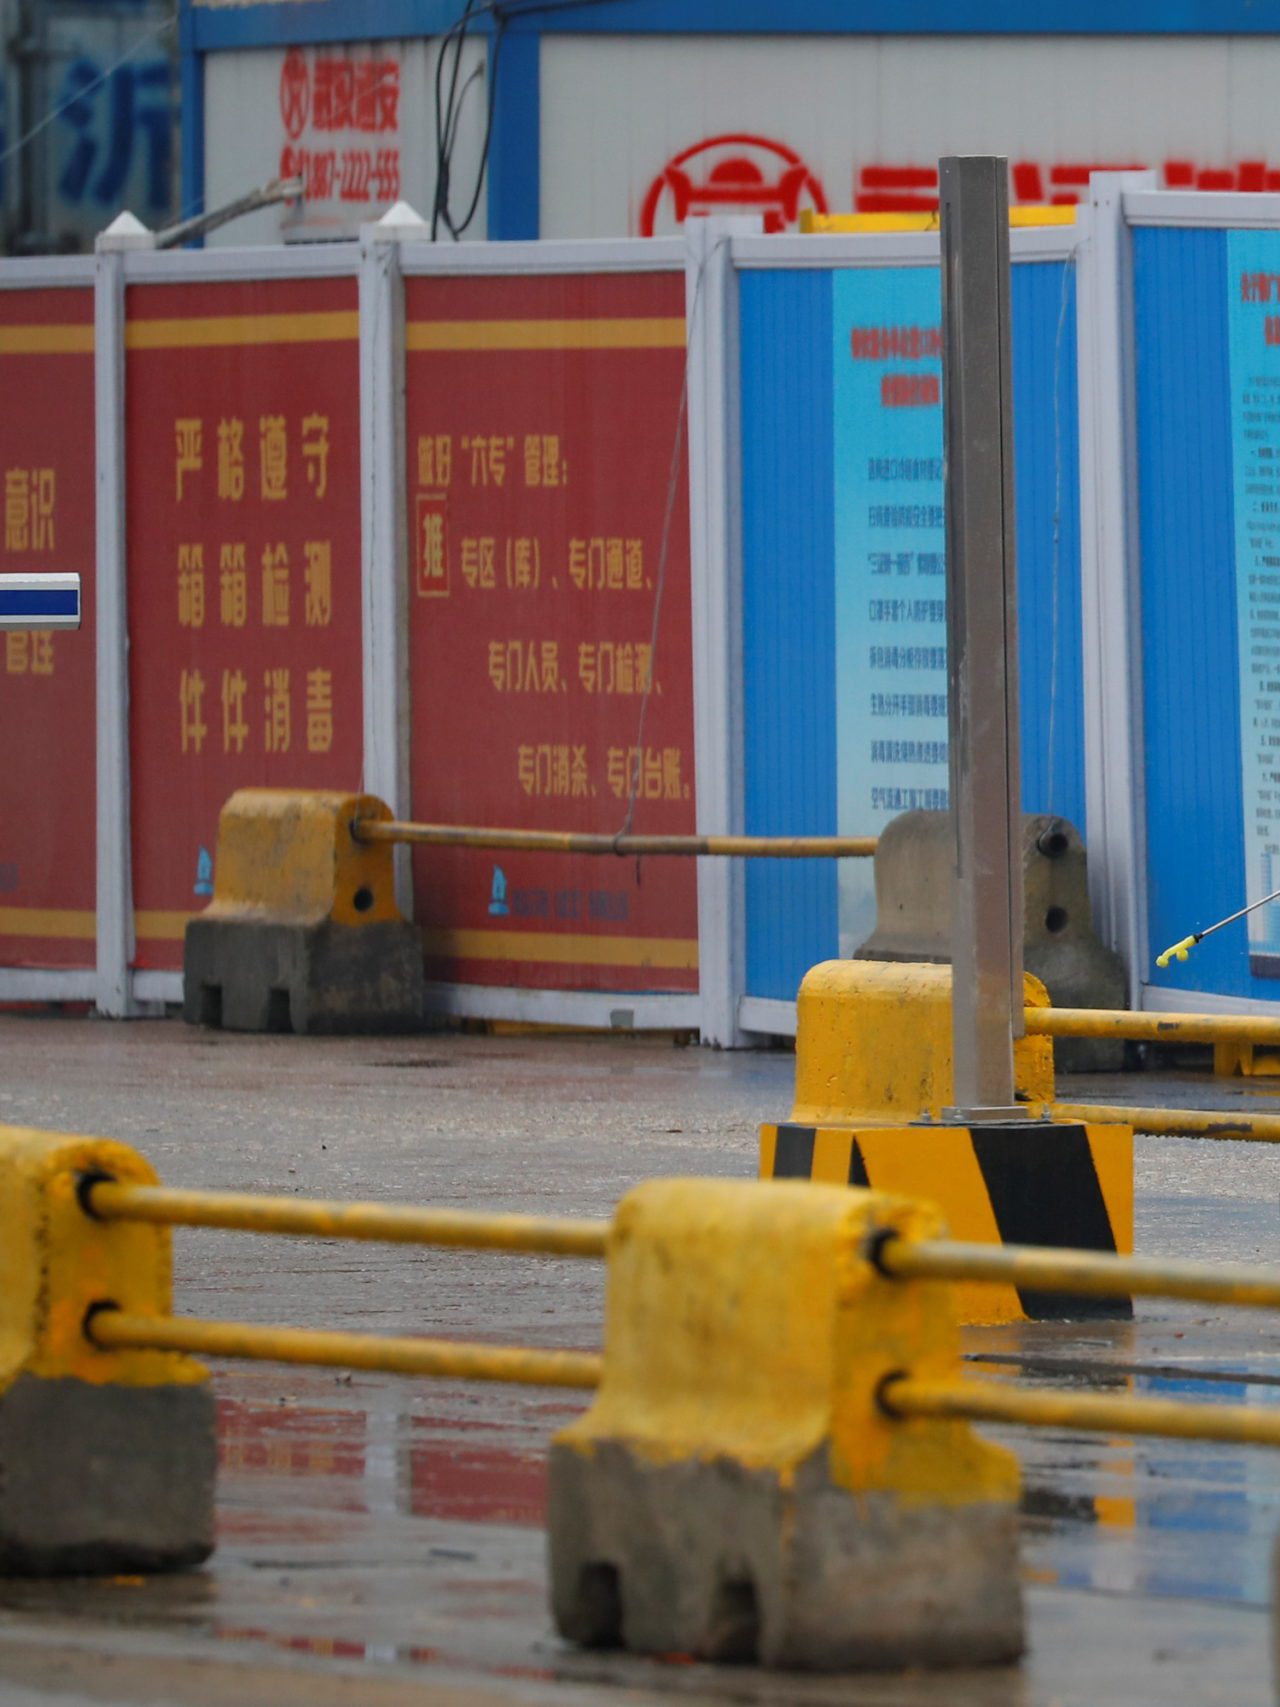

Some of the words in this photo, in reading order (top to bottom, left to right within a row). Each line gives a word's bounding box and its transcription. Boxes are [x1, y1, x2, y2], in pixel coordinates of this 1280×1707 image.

[175, 412, 329, 502] 严格遵守
[5, 467, 56, 552] 意识
[177, 540, 331, 628] 箱箱检测
[180, 667, 333, 754] 件件消毒
